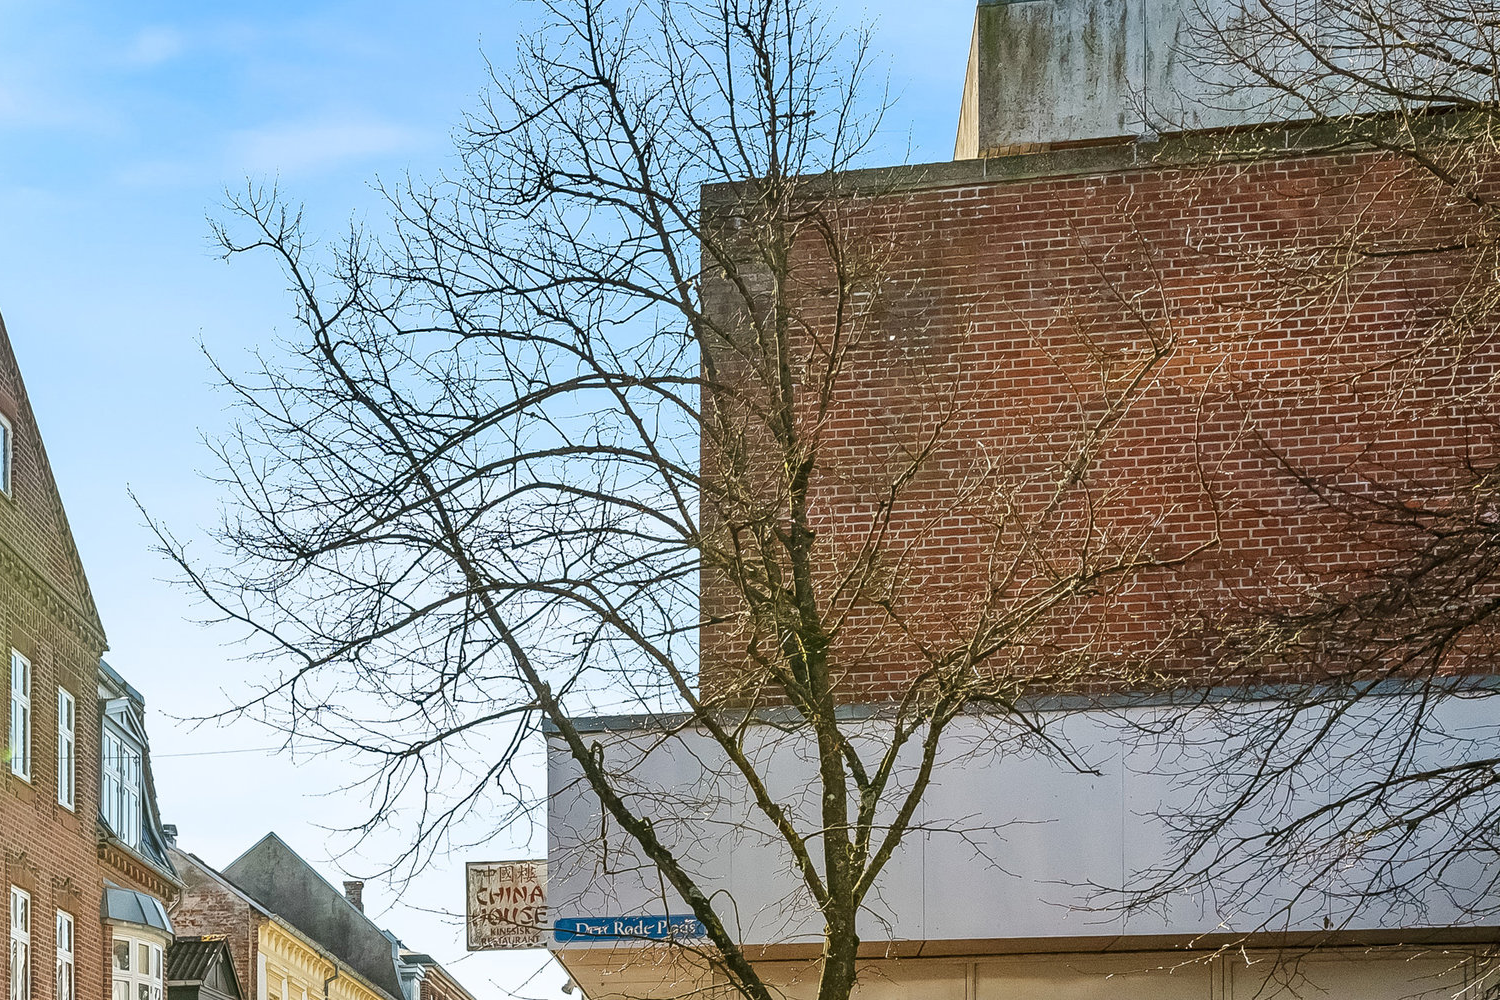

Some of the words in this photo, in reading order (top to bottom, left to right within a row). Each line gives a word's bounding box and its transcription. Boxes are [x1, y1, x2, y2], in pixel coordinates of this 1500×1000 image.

[477, 885, 544, 905] CHINA
[472, 906, 548, 926] HOUSE
[490, 926, 531, 936] KINESISK
[575, 922, 609, 937] Den
[481, 936, 541, 946] RESTAURANT
